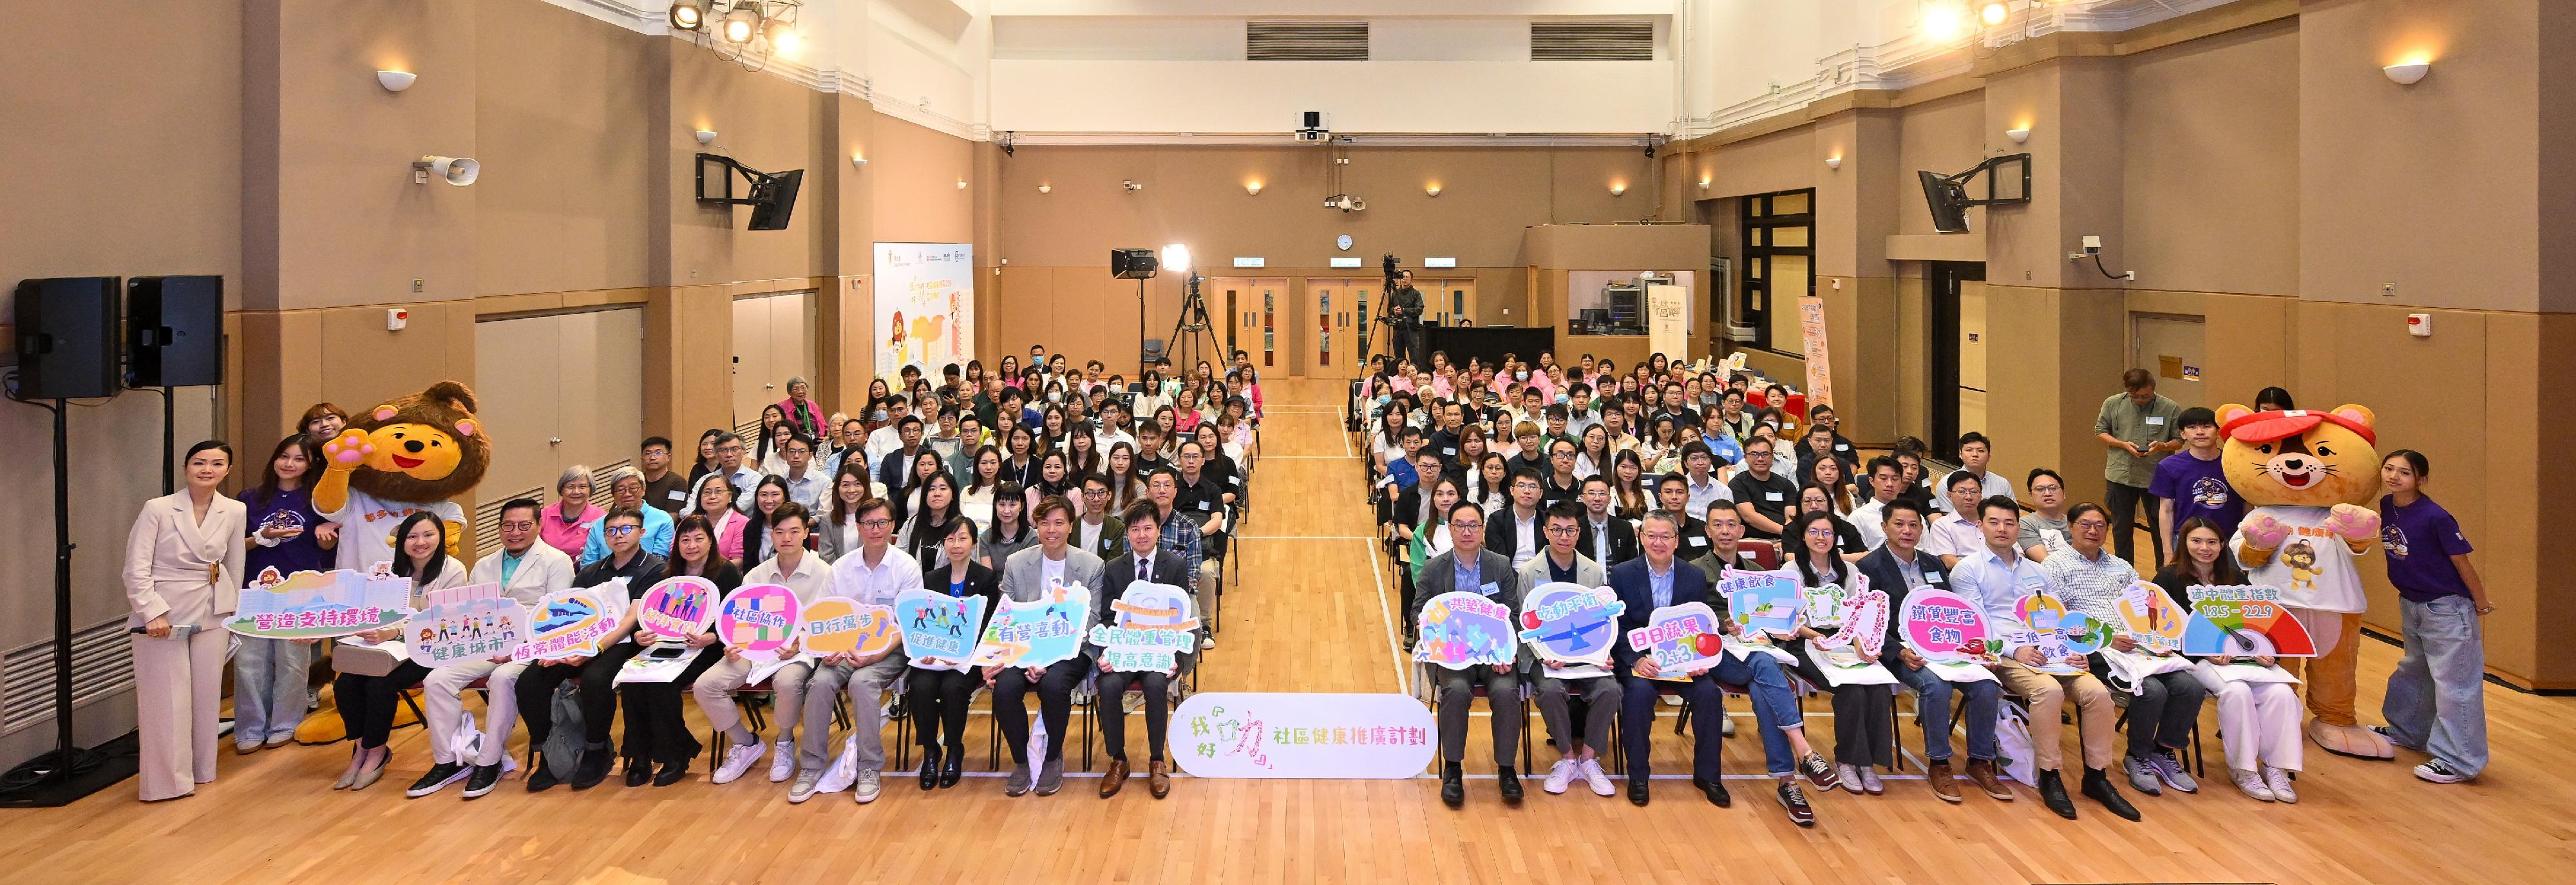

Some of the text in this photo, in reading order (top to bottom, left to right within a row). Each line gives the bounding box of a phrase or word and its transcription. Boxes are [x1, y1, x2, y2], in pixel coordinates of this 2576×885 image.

[1720, 574, 1776, 594] 健康飲食
[2192, 588, 2278, 601] 適中體重指數
[1450, 598, 1508, 621] 共築健康
[1537, 593, 1601, 620] 吃動平衡
[1911, 605, 1976, 624] 鐵質豐富
[256, 607, 381, 630] 營造支持環境
[733, 607, 786, 629] 社區協作
[811, 613, 873, 635] 日行萬步
[515, 616, 615, 661] 恆常體能活動
[998, 619, 1070, 643] 有營喜動
[1092, 629, 1192, 651] 全民體重管理
[1632, 618, 1700, 647] 日日蔬果
[1929, 627, 1962, 644] 食物
[2014, 628, 2069, 643] 三低一高
[431, 637, 504, 661] 健康城市
[909, 633, 960, 654] 促進健康
[2041, 644, 2069, 658] 飲食
[1107, 651, 1172, 669] 提高意識
[1656, 645, 1692, 667] 2+3
[1273, 726, 1426, 746] 社區健康推廣計劃
